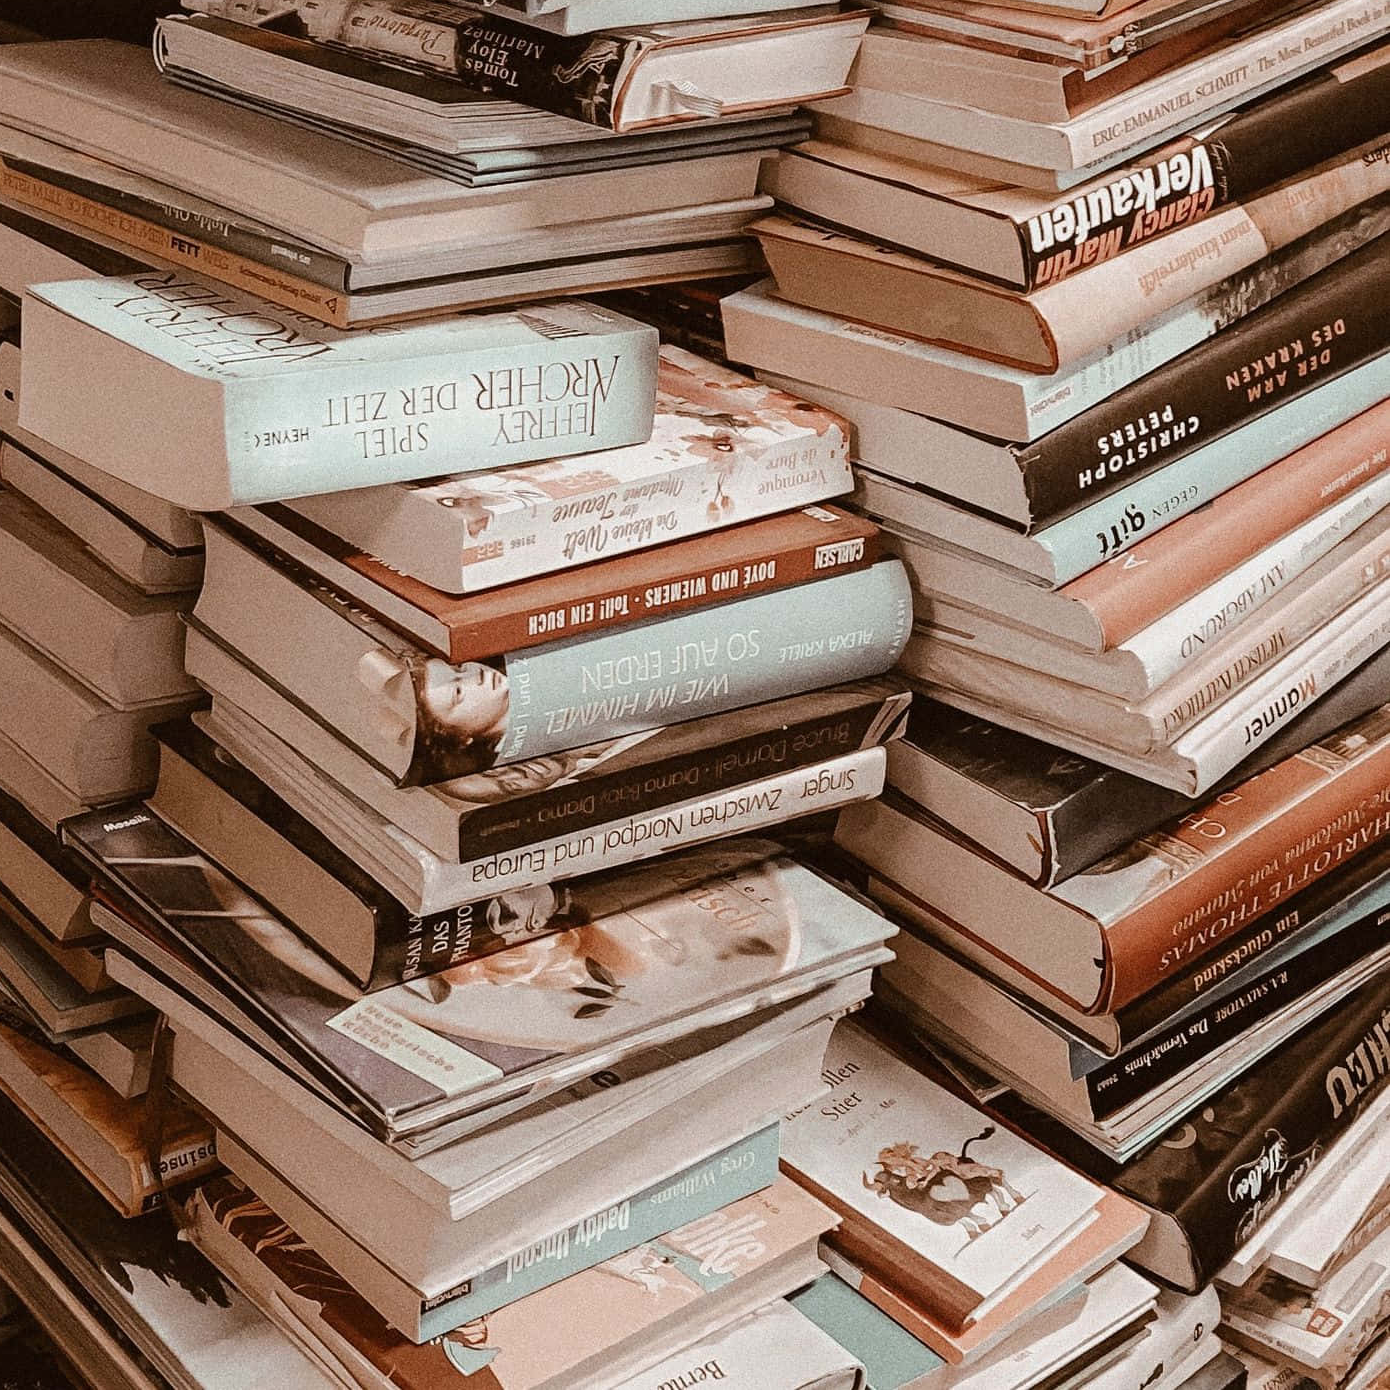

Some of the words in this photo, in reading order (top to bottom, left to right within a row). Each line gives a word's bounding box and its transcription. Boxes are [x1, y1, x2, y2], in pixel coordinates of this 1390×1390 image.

[466, 34, 510, 67] Eloy
[1020, 146, 1218, 256] Verkaufen
[1120, 185, 1223, 248] Clancy
[1027, 225, 1132, 287] Martin
[1308, 317, 1349, 347] DES
[1221, 338, 1309, 391] KRAKEN
[1294, 347, 1335, 377] DER
[398, 382, 460, 416] DER
[472, 354, 622, 417] ARCHER
[1243, 370, 1292, 402] ARM
[317, 391, 389, 427] ZEIT
[490, 390, 606, 450] JEFFREY
[260, 426, 311, 448] HEYNE
[352, 421, 431, 460] SPIEL
[1093, 403, 1177, 456] PETERS
[1072, 413, 1203, 489] CHRISTOPH
[1149, 484, 1201, 519] GEGEN
[557, 523, 610, 561] Welt
[607, 516, 657, 549] kleine
[1088, 503, 1151, 558] gift
[811, 540, 866, 570] CARLSEN
[642, 575, 709, 608] WIEMERS
[708, 568, 741, 593] UND
[739, 560, 778, 589] DOYÉ
[524, 608, 568, 635] BUCH
[566, 601, 597, 625] EIN
[596, 593, 632, 620] Toll!
[1174, 583, 1263, 659] ABGRUND
[667, 637, 722, 674] AUF
[721, 628, 764, 662] SO
[826, 626, 876, 653] ALEXA
[577, 649, 665, 693] ERDEN
[678, 672, 731, 705] WIE
[541, 692, 642, 734] HIMMEL
[640, 683, 680, 712] IM
[1235, 673, 1323, 746] Männer
[788, 720, 854, 755] Bruce
[710, 738, 790, 776] Darnell
[644, 764, 703, 796] Drama
[794, 763, 858, 800] Singer
[101, 811, 152, 834] Mosaik
[535, 794, 598, 827] Drama
[683, 788, 786, 831] Zwischen
[596, 805, 686, 857] Nordpol
[467, 840, 549, 890] Europa
[548, 834, 597, 866] und
[430, 919, 451, 953] DAS
[1273, 910, 1302, 934] Ein
[1185, 1017, 1210, 1039] Das
[818, 1086, 863, 1125] Stier
[717, 1147, 759, 1179] Greg
[646, 1168, 718, 1210] Williams
[570, 1200, 638, 1249] Daddy
[499, 1229, 577, 1281] Uncool
